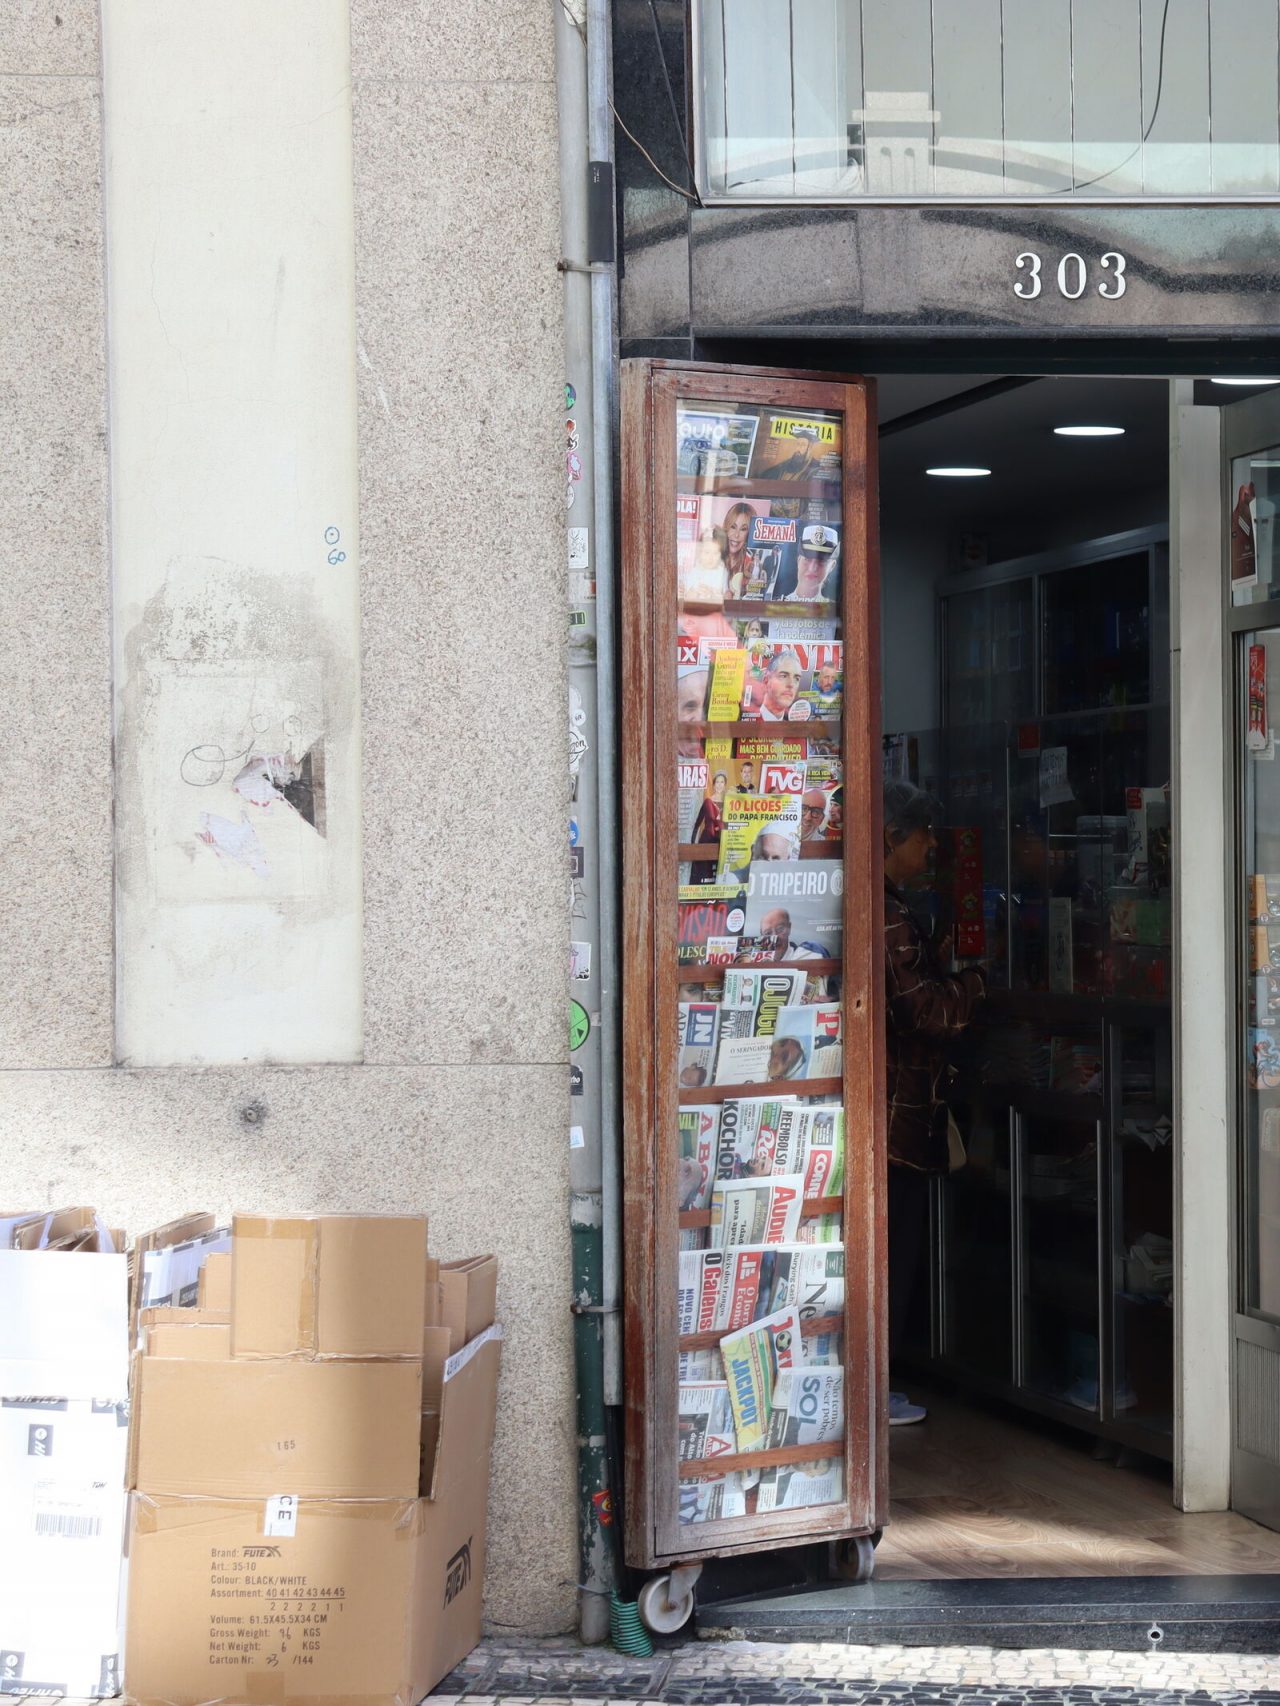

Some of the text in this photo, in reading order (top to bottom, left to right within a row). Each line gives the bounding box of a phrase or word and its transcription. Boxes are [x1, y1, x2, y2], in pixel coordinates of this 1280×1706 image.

[1013, 252, 1126, 299] 303
[753, 518, 796, 543] SEMANA
[729, 800, 741, 812] 10
[727, 813, 738, 821] DO
[739, 813, 758, 821] PAPA
[759, 871, 828, 897] TRIPEIRO
[692, 1012, 713, 1043] JN
[775, 1110, 793, 1166] REEMBOLSO
[704, 1252, 722, 1265] O
[789, 1252, 800, 1283] Burying
[723, 1270, 732, 1285] dos
[685, 1288, 694, 1313] NOVO
[731, 1359, 758, 1427] JACKPOT
[823, 1391, 832, 1406] ser
[799, 1376, 821, 1425] SOL
[829, 1399, 840, 1431] temos
[276, 1440, 296, 1451] 165
[211, 1548, 240, 1558] Brand:
[232, 1562, 257, 1571] 35-10
[211, 1575, 308, 1585] Colour: BLACK/WHITE
[210, 1587, 345, 1598] Assortment: 40 41 42 43 44 45
[270, 1602, 343, 1612] 2 2 2 2 1 1
[210, 1614, 328, 1624] Volume: 61.5X45.5X34 CM
[209, 1628, 235, 1638] Gross
[237, 1628, 271, 1639] Weight:
[303, 1628, 321, 1637] KGS
[209, 1642, 225, 1651] Net
[227, 1641, 261, 1653] Weight:
[302, 1641, 321, 1650] KGS
[209, 1655, 238, 1665] Carton
